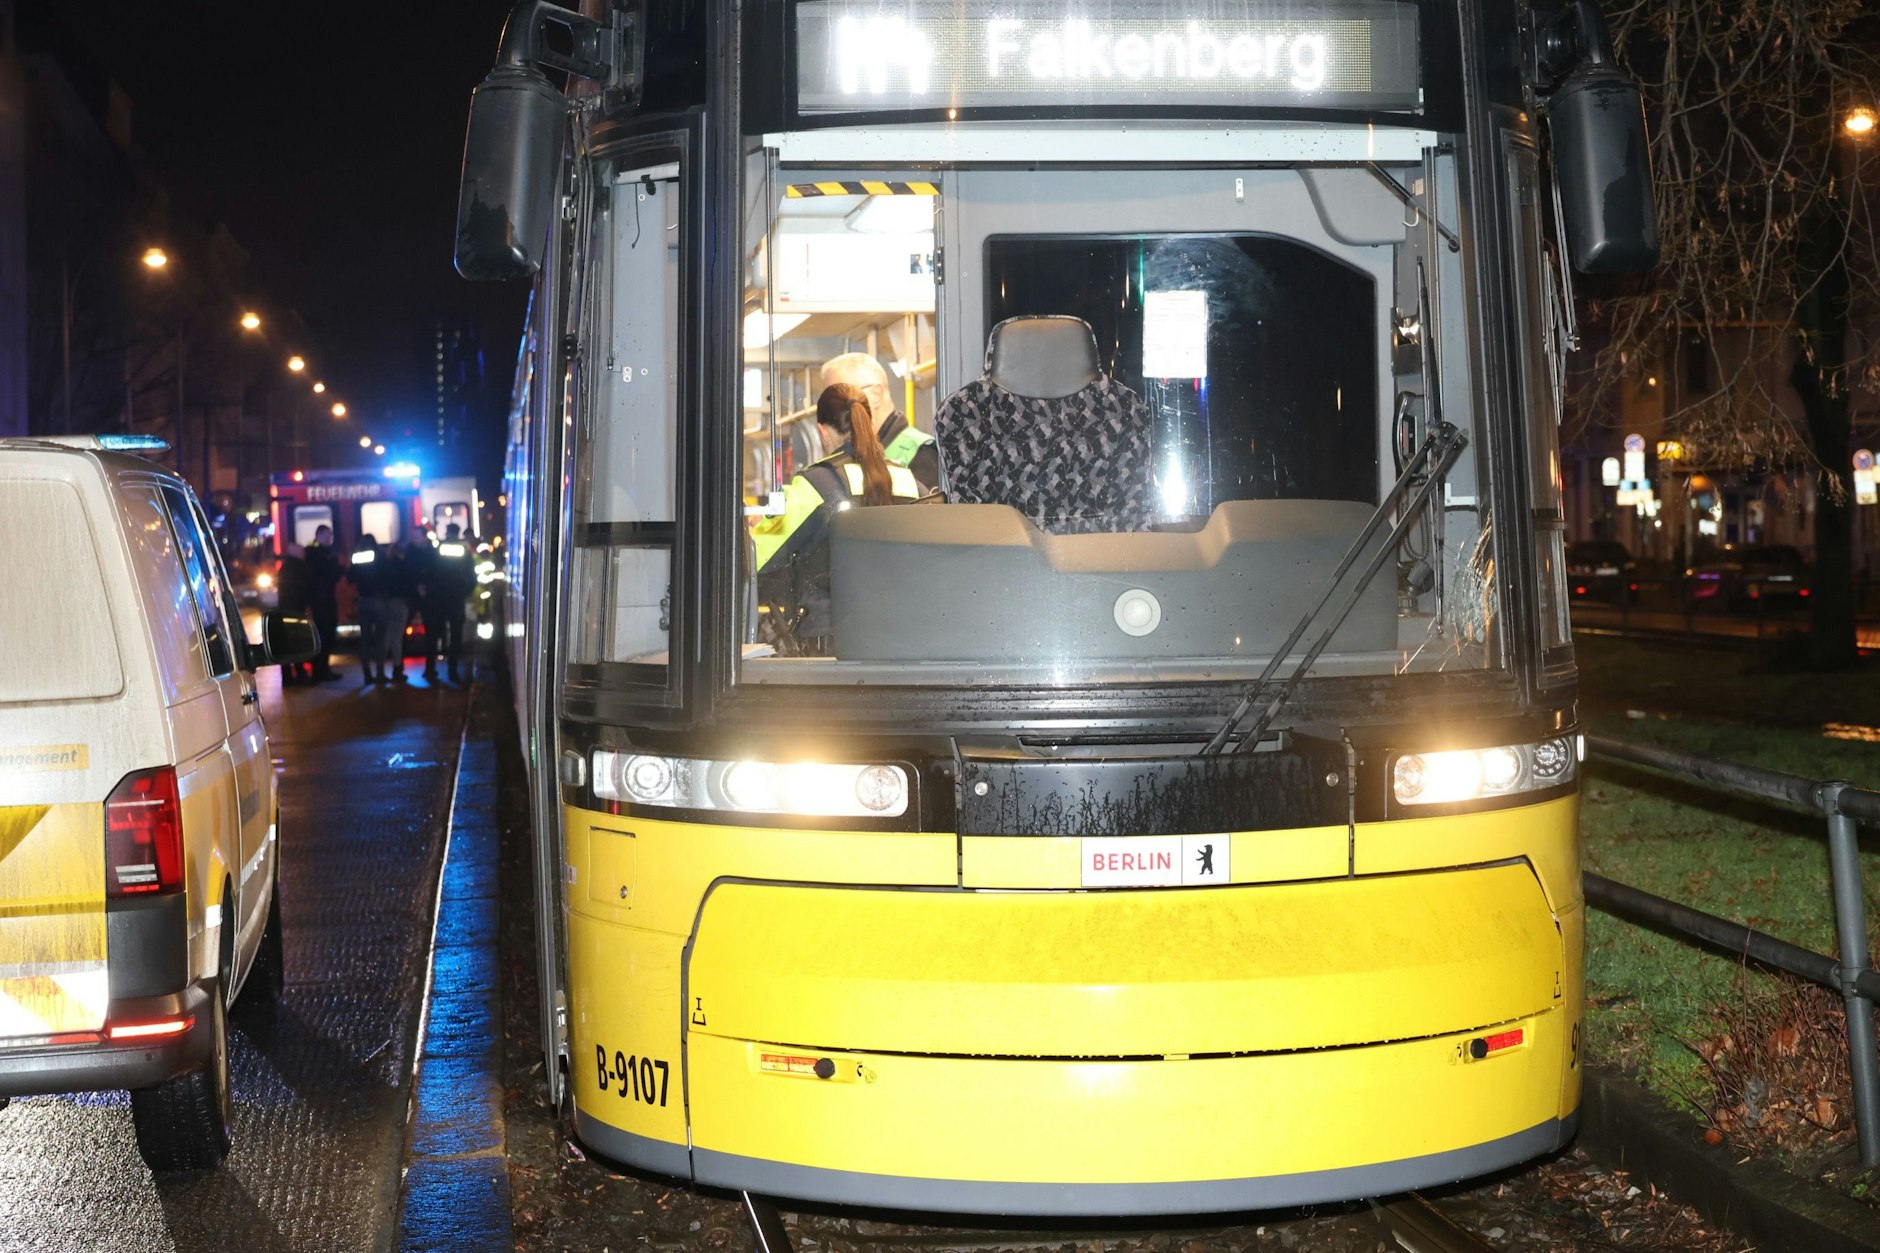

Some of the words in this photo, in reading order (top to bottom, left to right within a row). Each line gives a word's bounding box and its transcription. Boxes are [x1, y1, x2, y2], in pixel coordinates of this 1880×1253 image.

[985, 18, 1328, 91] Falkenberg
[306, 484, 381, 501] FEUERWEHR
[1092, 852, 1172, 871] BERLIN
[595, 1044, 670, 1108] B-9107
